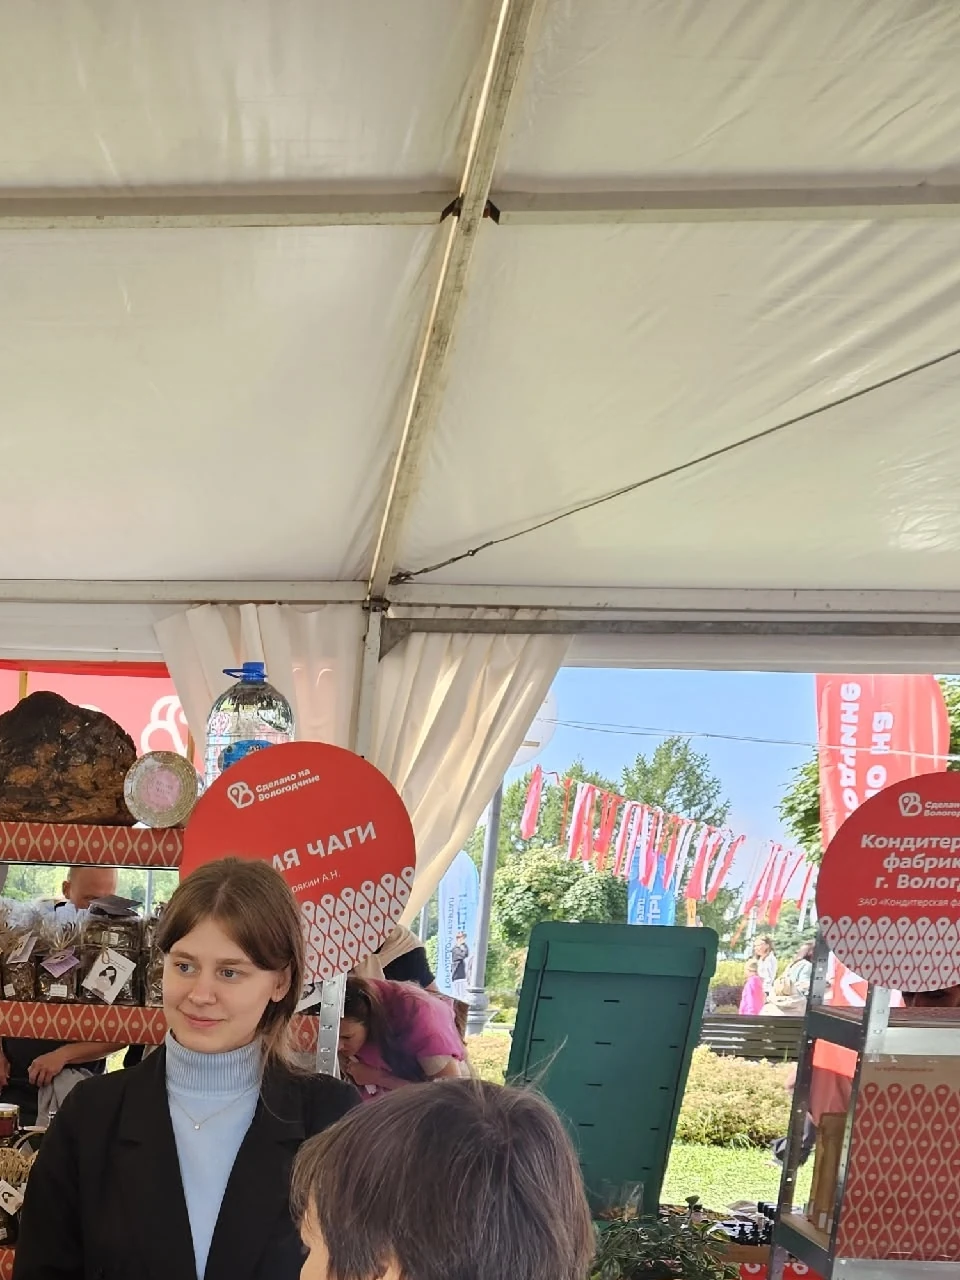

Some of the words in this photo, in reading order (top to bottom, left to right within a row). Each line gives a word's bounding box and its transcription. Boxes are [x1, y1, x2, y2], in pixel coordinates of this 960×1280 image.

[255, 773, 297, 793] Сделано
[298, 768, 311, 778] на
[258, 775, 320, 802] Вологодчине
[306, 821, 377, 858] ЧАГИ
[291, 877, 320, 894] рякин
[875, 876, 889, 889] г.
